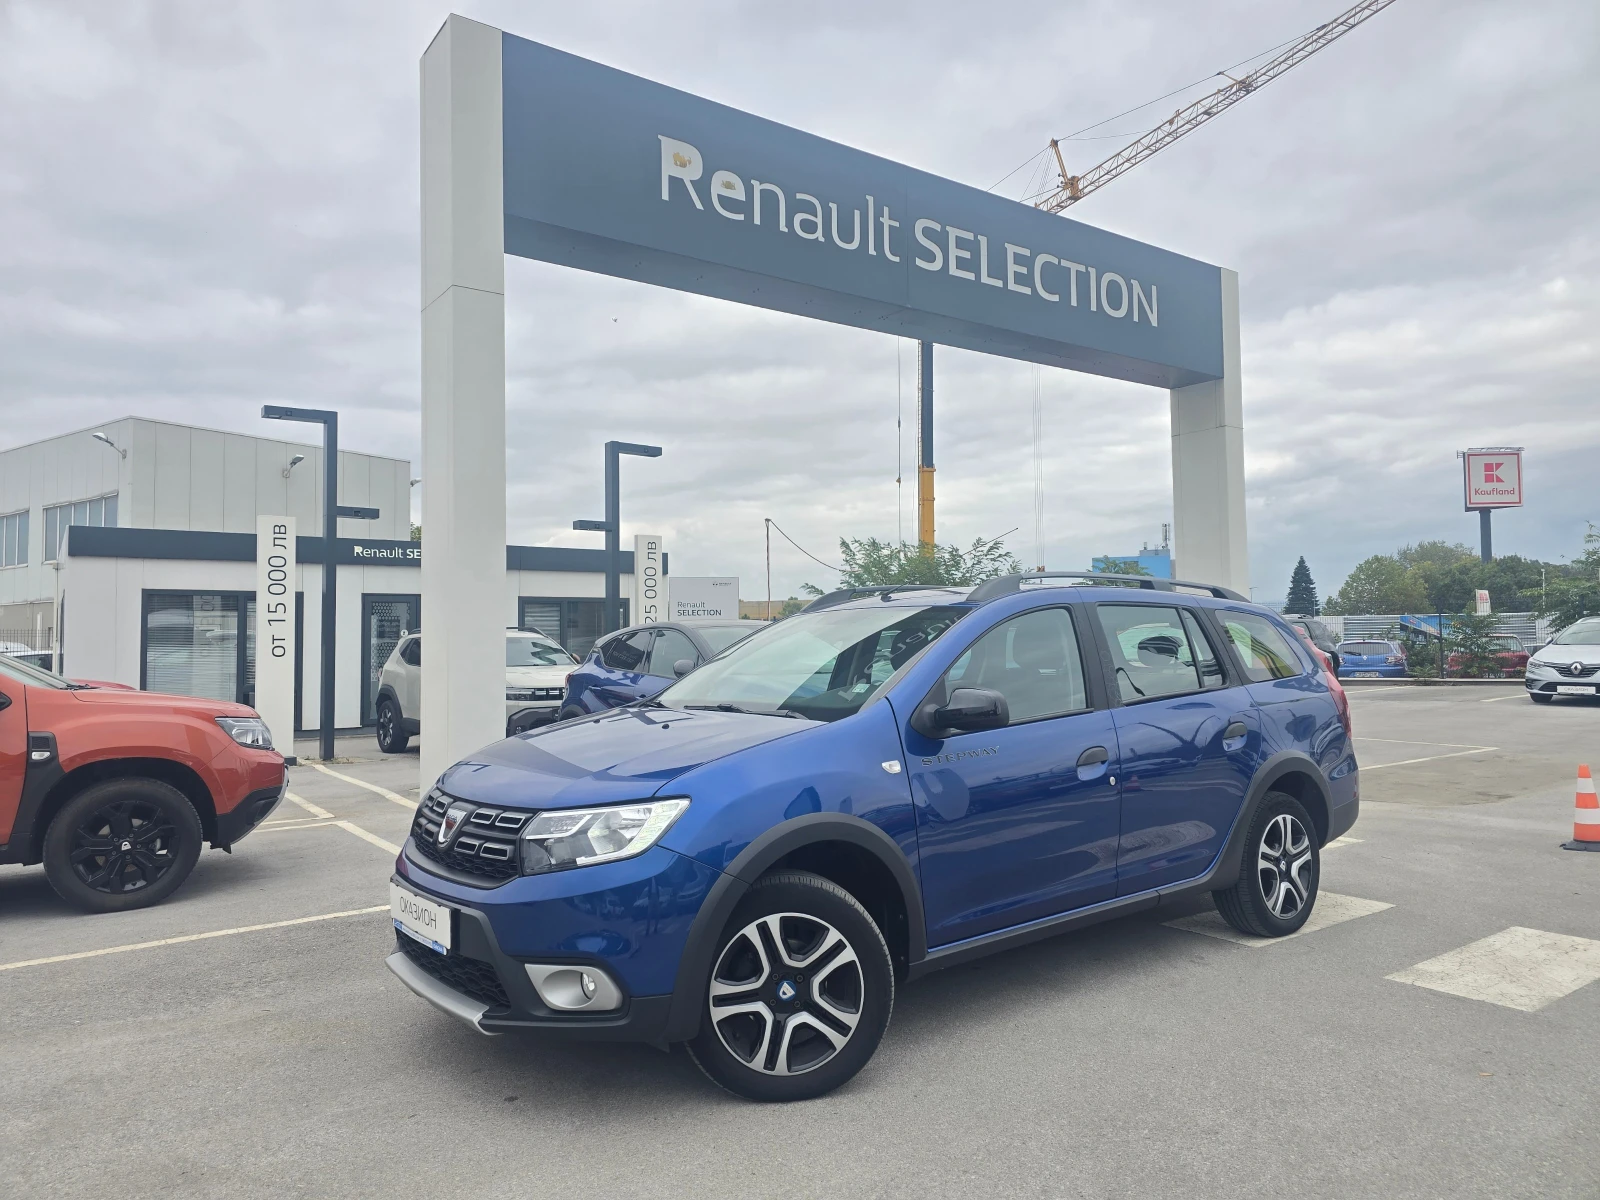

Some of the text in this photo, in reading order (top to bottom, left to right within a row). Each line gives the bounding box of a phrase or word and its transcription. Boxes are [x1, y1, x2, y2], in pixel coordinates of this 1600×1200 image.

[657, 134, 1159, 327] Renault SELECTION
[1474, 487, 1515, 496] Kaufland
[353, 545, 404, 559] Renault
[267, 555, 287, 596] 000
[644, 566, 658, 599] 000
[267, 602, 287, 627] 15
[677, 601, 706, 609] Renault
[677, 609, 722, 617] SELECTION
[921, 745, 1000, 767] STEPWAY
[400, 896, 437, 930] ОКАЗИОН
